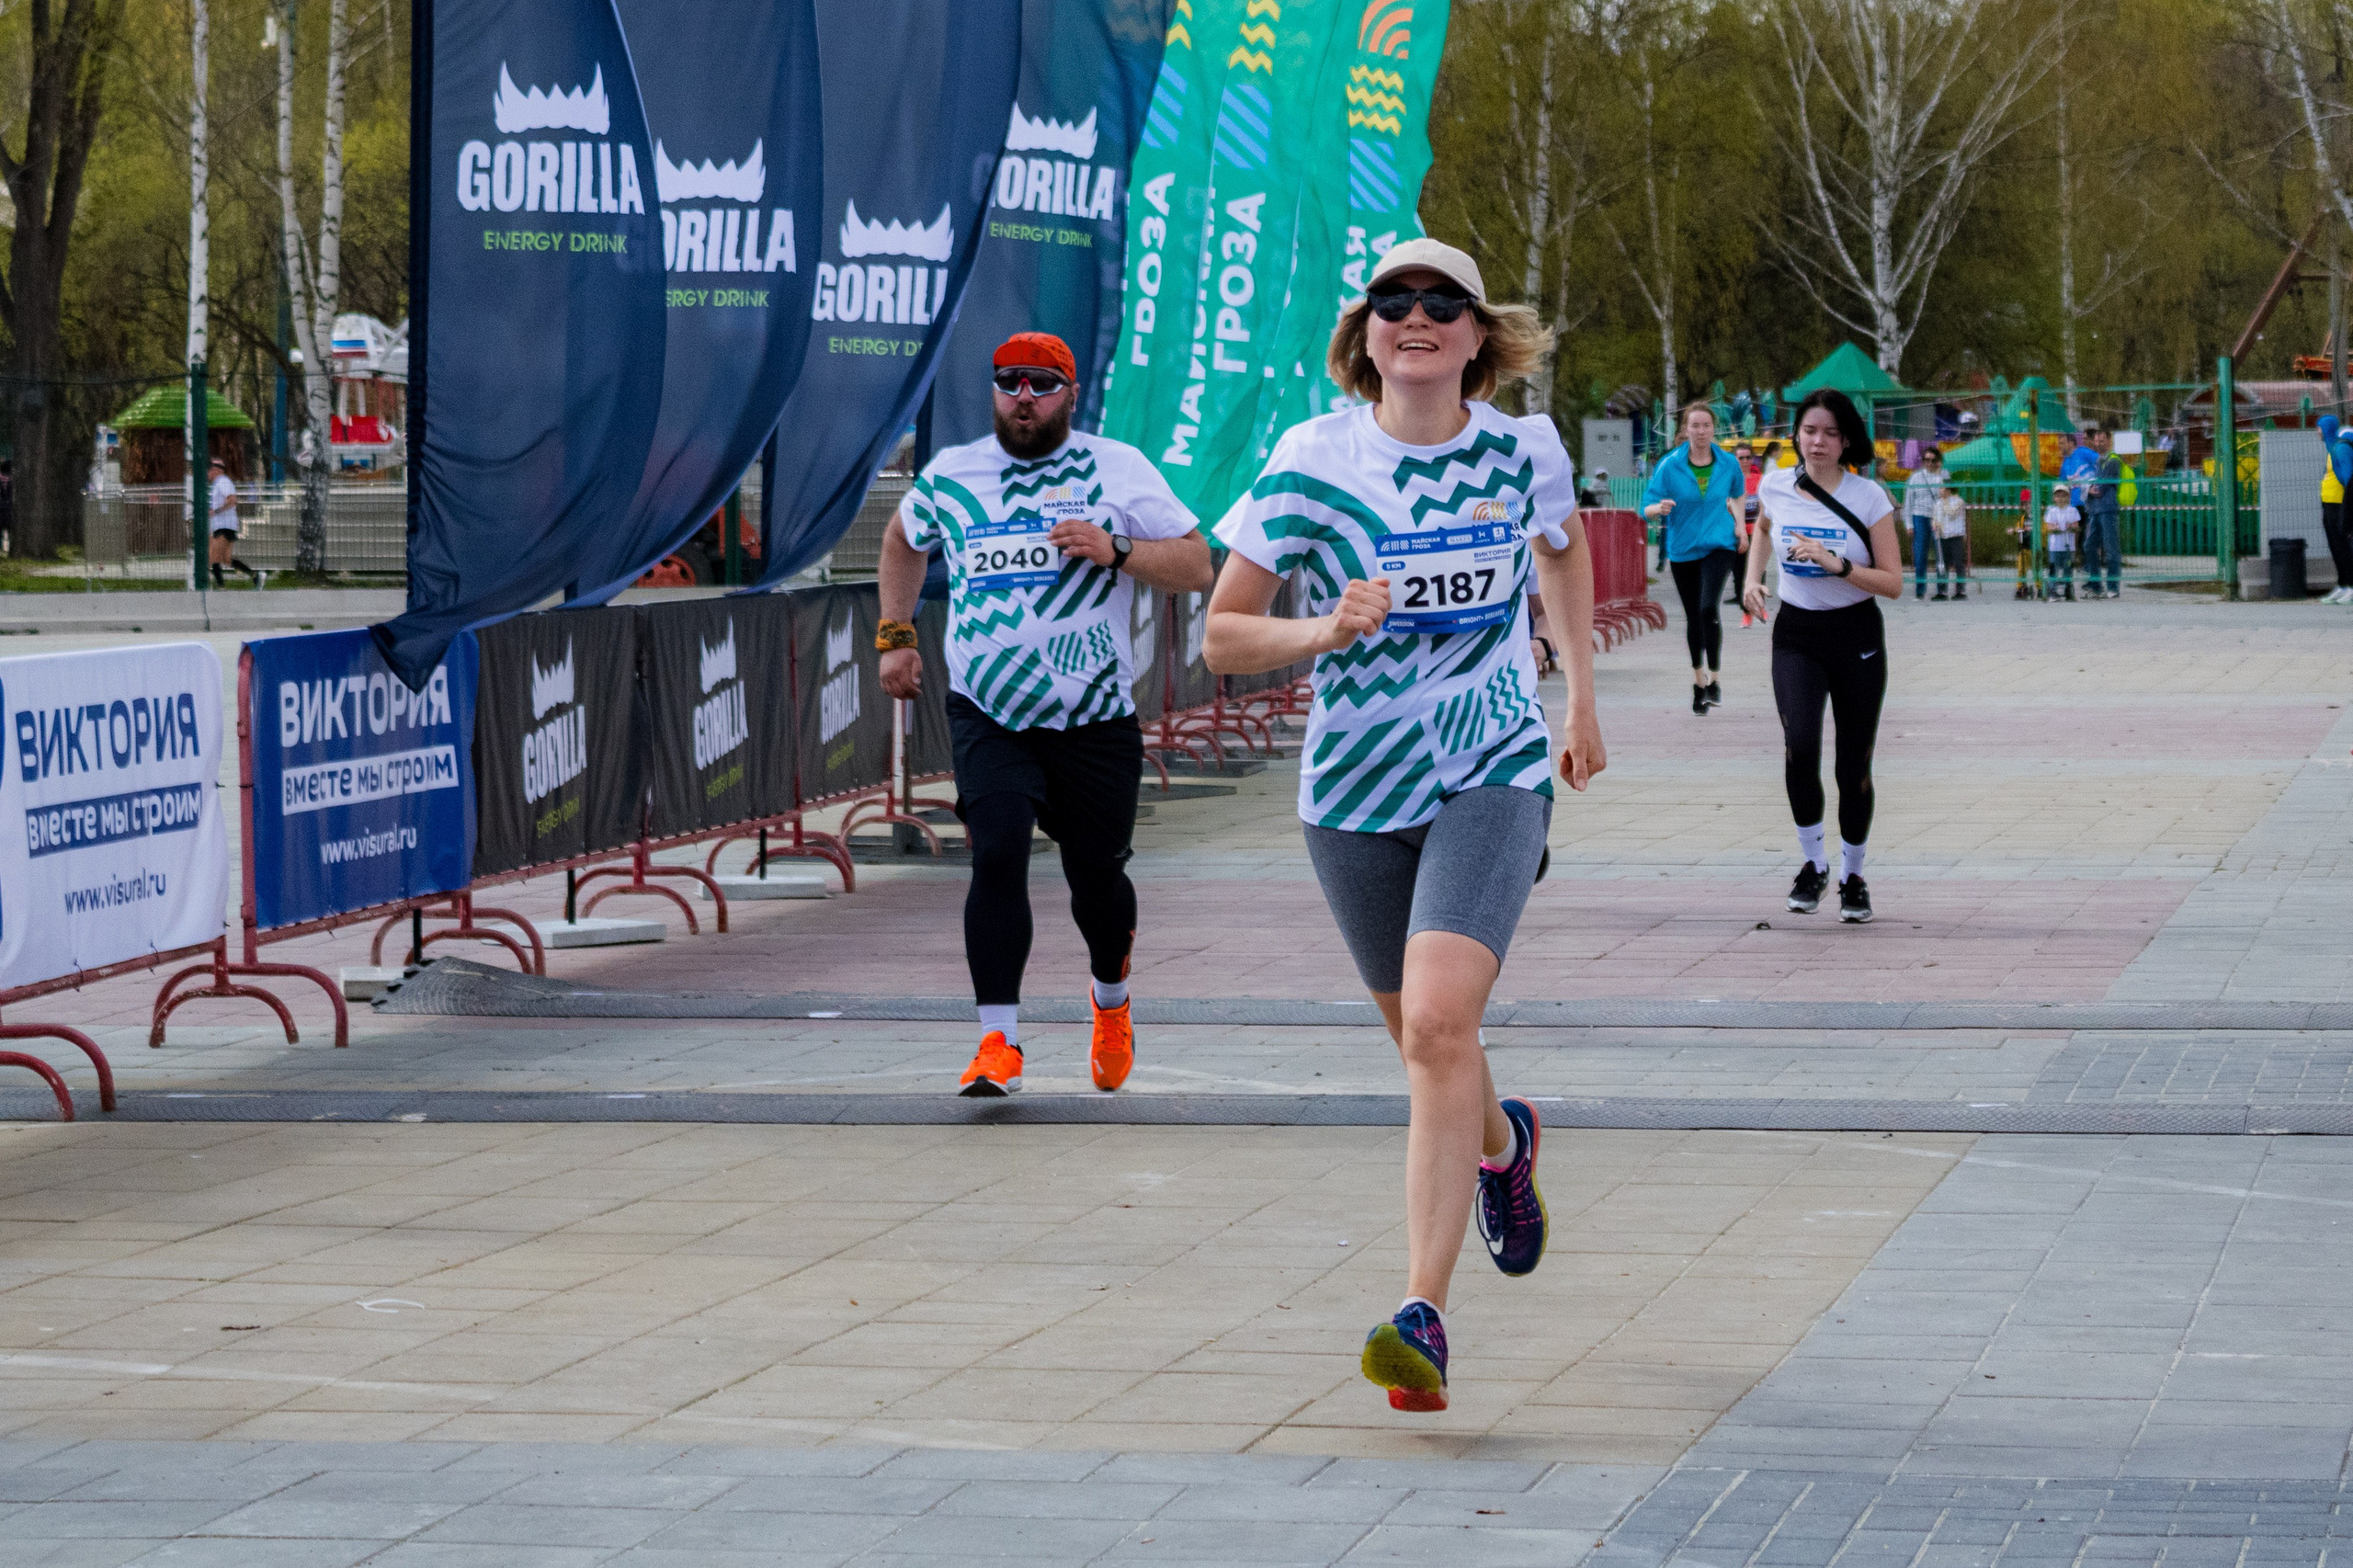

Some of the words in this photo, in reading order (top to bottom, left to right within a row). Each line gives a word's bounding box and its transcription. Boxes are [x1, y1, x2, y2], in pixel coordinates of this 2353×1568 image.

[458, 140, 645, 215] GORILLA
[991, 154, 1117, 222] ORILLA
[483, 230, 564, 252] ENERGY
[570, 232, 628, 254] DRINK
[662, 208, 797, 274] RILLA
[988, 222, 1055, 244] ENERGY
[1057, 228, 1094, 249] DRINK
[666, 289, 710, 307] ERGY
[713, 289, 770, 308] DRINK
[812, 263, 949, 325] GORILL
[1211, 191, 1267, 373] ГРОЗА
[828, 336, 900, 357] ENERGY
[1043, 500, 1086, 509] МАЙСКАЯ
[974, 546, 1050, 574] 2040
[1473, 548, 1512, 559] ВИКТОРИЯ
[1404, 568, 1496, 608] 2187
[280, 665, 452, 747] ВИКТОРИЯ
[694, 678, 749, 770] GORILLA
[820, 664, 860, 745] GORILLA
[16, 693, 200, 782] ВИКТОРИЯ
[523, 704, 587, 804] GORILLA
[286, 767, 353, 806] вместе
[358, 764, 382, 794] мы
[387, 753, 454, 795] строим
[28, 804, 97, 850] вместе
[100, 801, 129, 835] мы
[132, 790, 201, 835] строим
[322, 823, 417, 865] www.visural.ru
[64, 868, 166, 915] www.visural.ru
